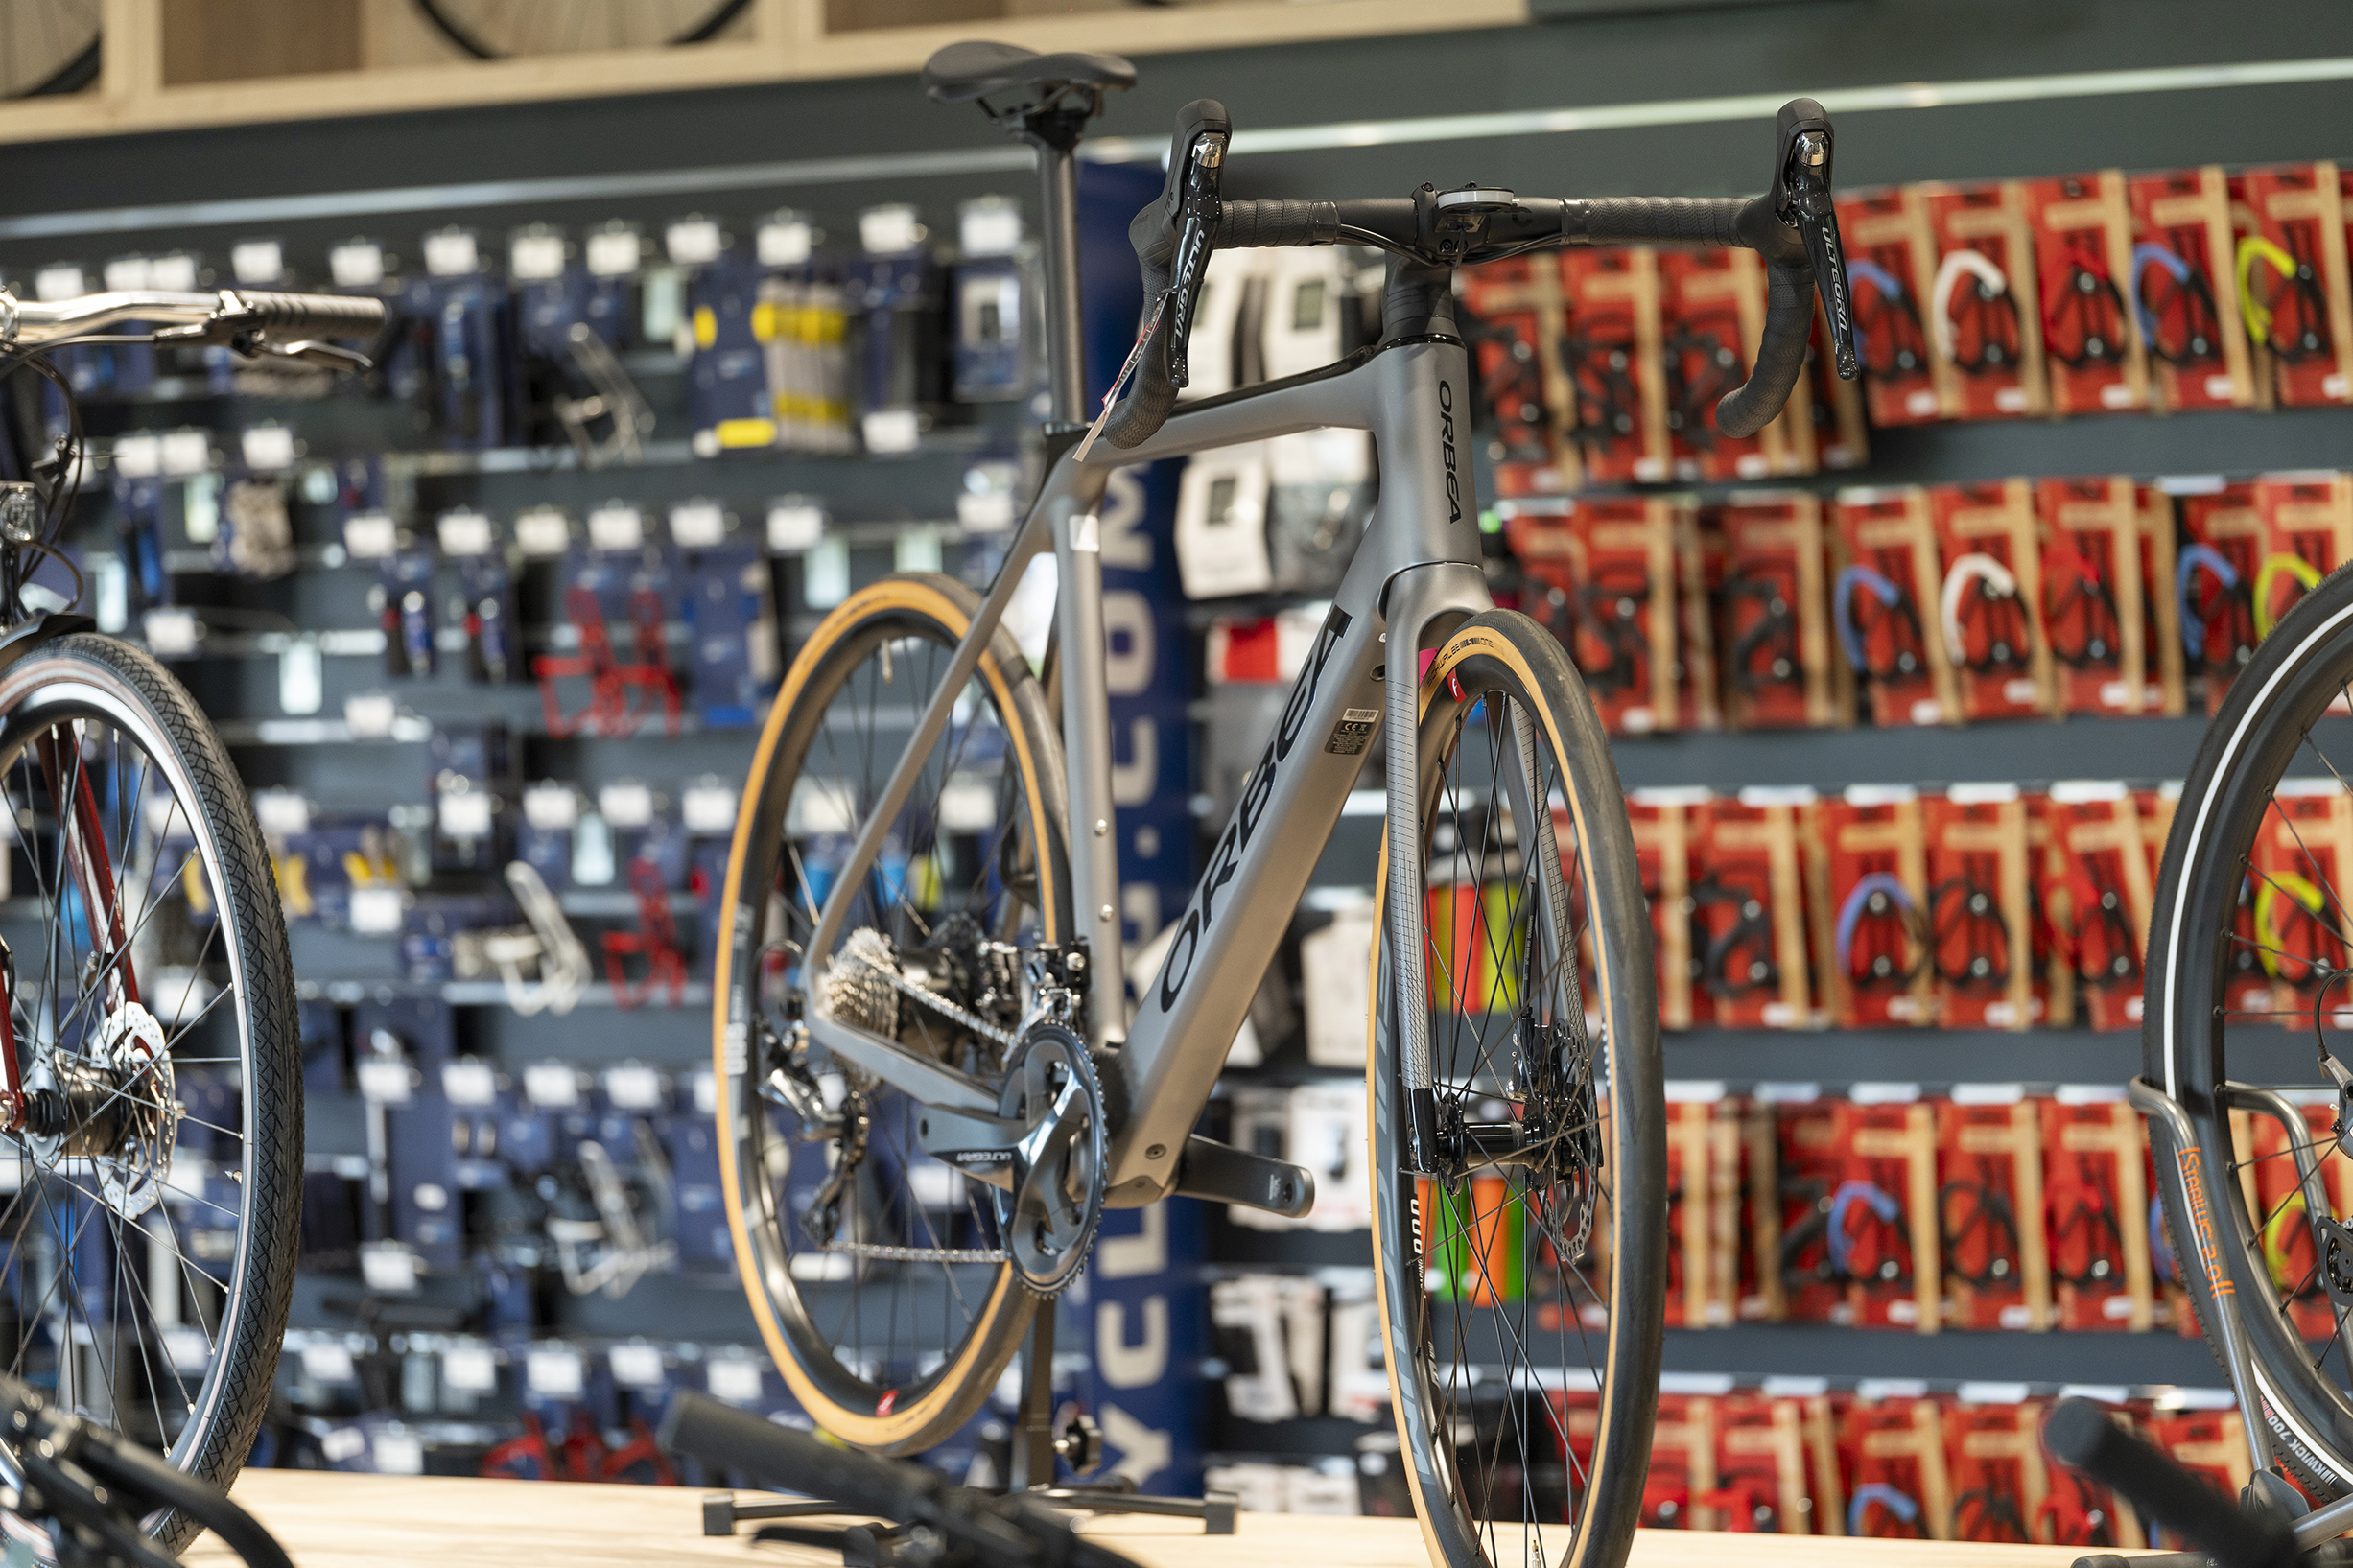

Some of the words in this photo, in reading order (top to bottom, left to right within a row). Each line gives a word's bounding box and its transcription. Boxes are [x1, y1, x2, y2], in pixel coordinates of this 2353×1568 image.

[1175, 229, 1205, 339] ULTEGRA
[1822, 226, 1847, 332] ULTEGRA
[1439, 380, 1462, 525] ORBEA
[1159, 604, 1353, 1014] ORBEA
[2202, 1244, 2223, 1282] 2.0
[2267, 1415, 2293, 1441] 700
[2287, 1438, 2329, 1478] KWICK
